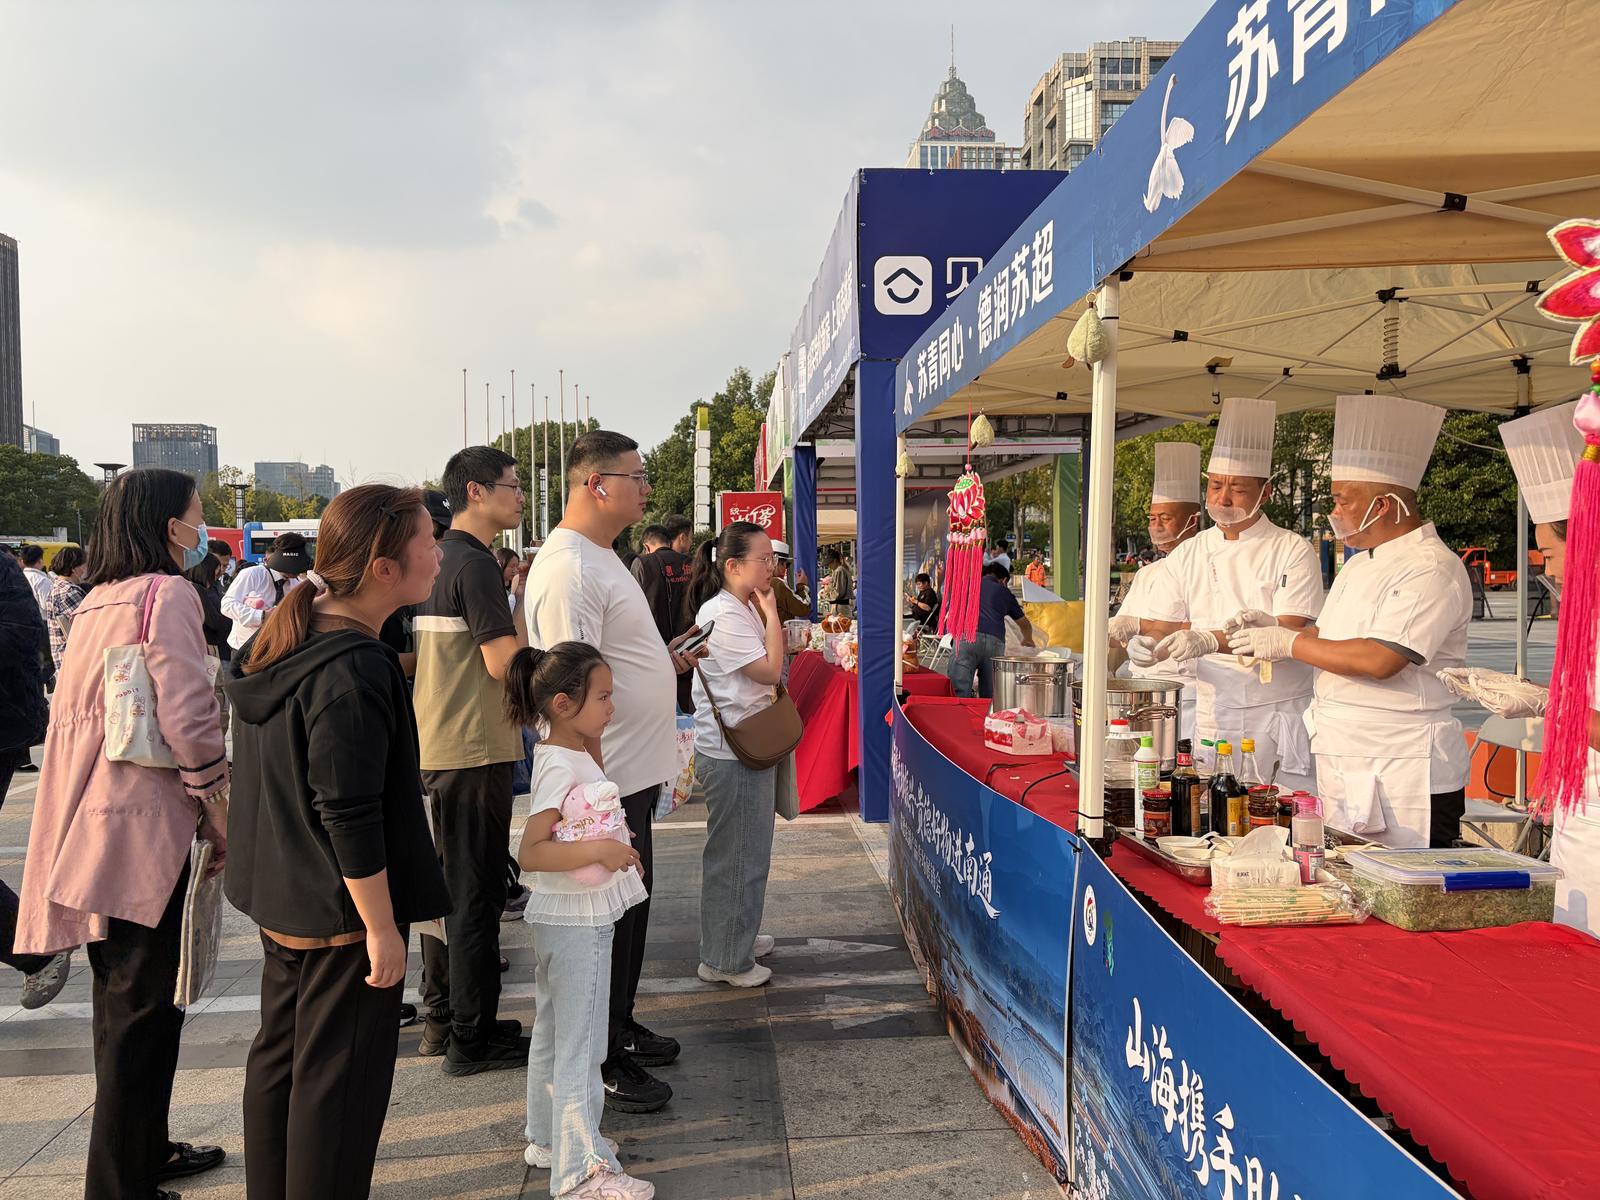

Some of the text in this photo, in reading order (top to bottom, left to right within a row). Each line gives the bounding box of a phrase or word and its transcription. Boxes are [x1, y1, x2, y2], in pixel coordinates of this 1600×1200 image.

[1226, 0, 1386, 145] 苏青
[917, 219, 1054, 402] 苏青同心·德润苏超
